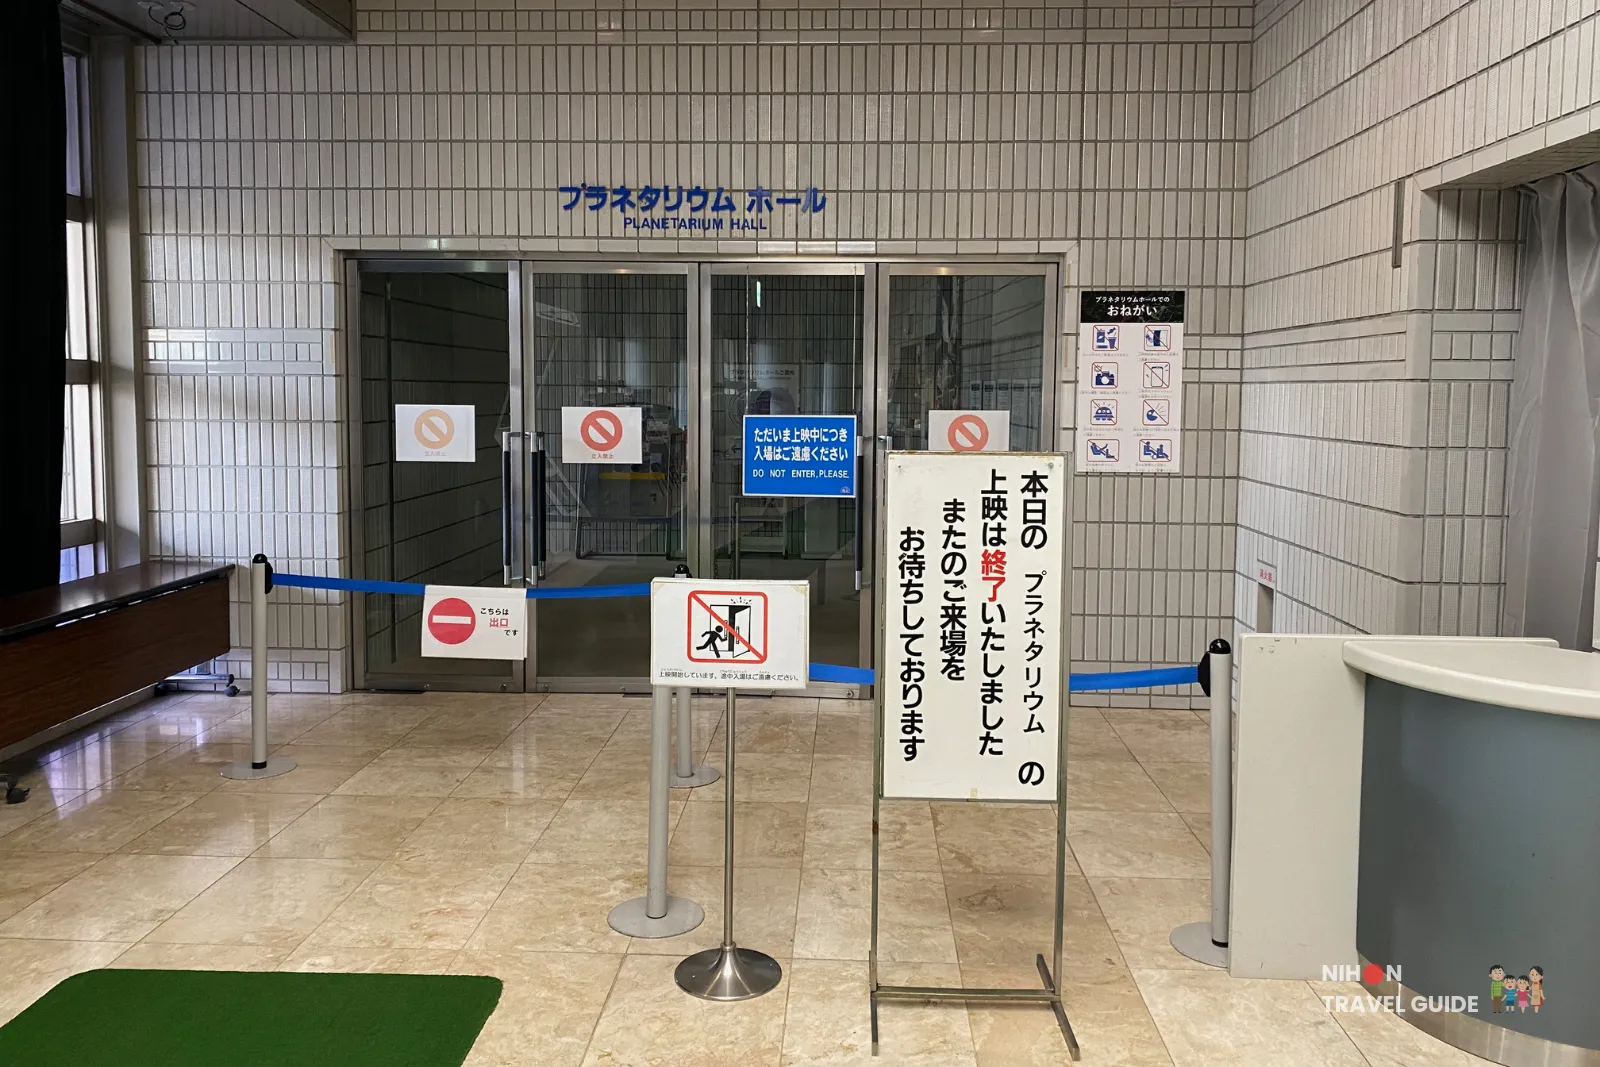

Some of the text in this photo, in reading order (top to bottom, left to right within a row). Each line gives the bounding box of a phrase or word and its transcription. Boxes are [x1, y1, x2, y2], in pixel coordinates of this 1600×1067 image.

[559, 183, 826, 214] プラネタリウム ホール
[623, 217, 767, 231] PLANETARIUM HALL
[1107, 304, 1158, 317] おねがい
[754, 427, 848, 443] ただいま上映中につき
[753, 445, 848, 462] 入場はご遠慮ください
[752, 469, 764, 478] DO
[770, 469, 786, 478] NOT
[940, 498, 968, 681] またのご来場を
[480, 607, 509, 616] こちらは
[979, 468, 1008, 757] 上映は終了いたしました
[489, 618, 509, 628] 出口
[1018, 470, 1048, 786] 本日の プラネタリウム の
[899, 526, 926, 761] お待ちしております
